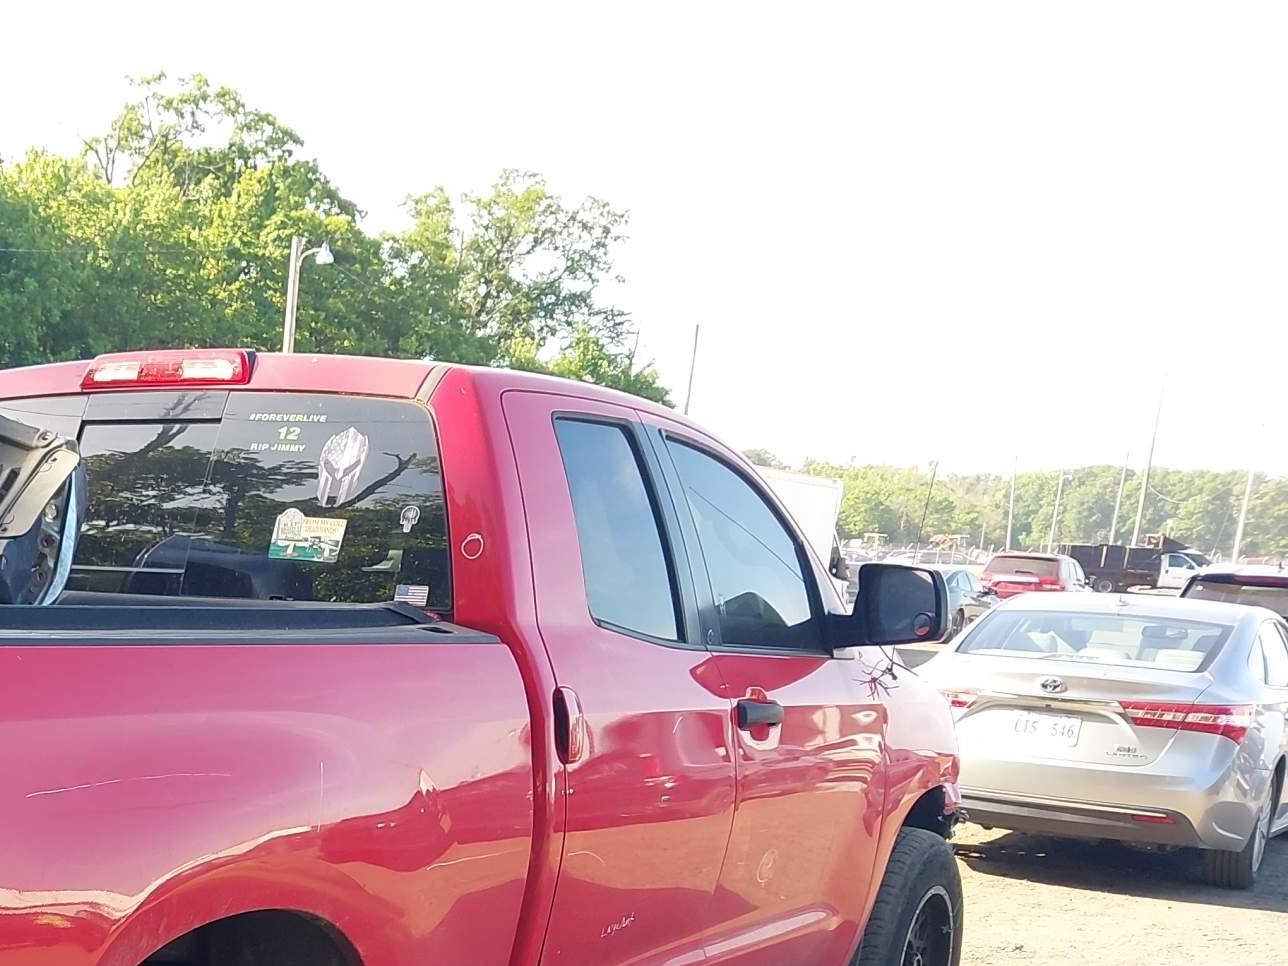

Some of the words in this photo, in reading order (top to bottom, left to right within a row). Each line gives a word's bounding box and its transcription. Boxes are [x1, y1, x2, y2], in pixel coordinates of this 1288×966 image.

[249, 413, 327, 422] #FOREVERLIVE
[278, 425, 301, 440] 12
[250, 443, 269, 451] RIP
[270, 443, 306, 452] JIMMY
